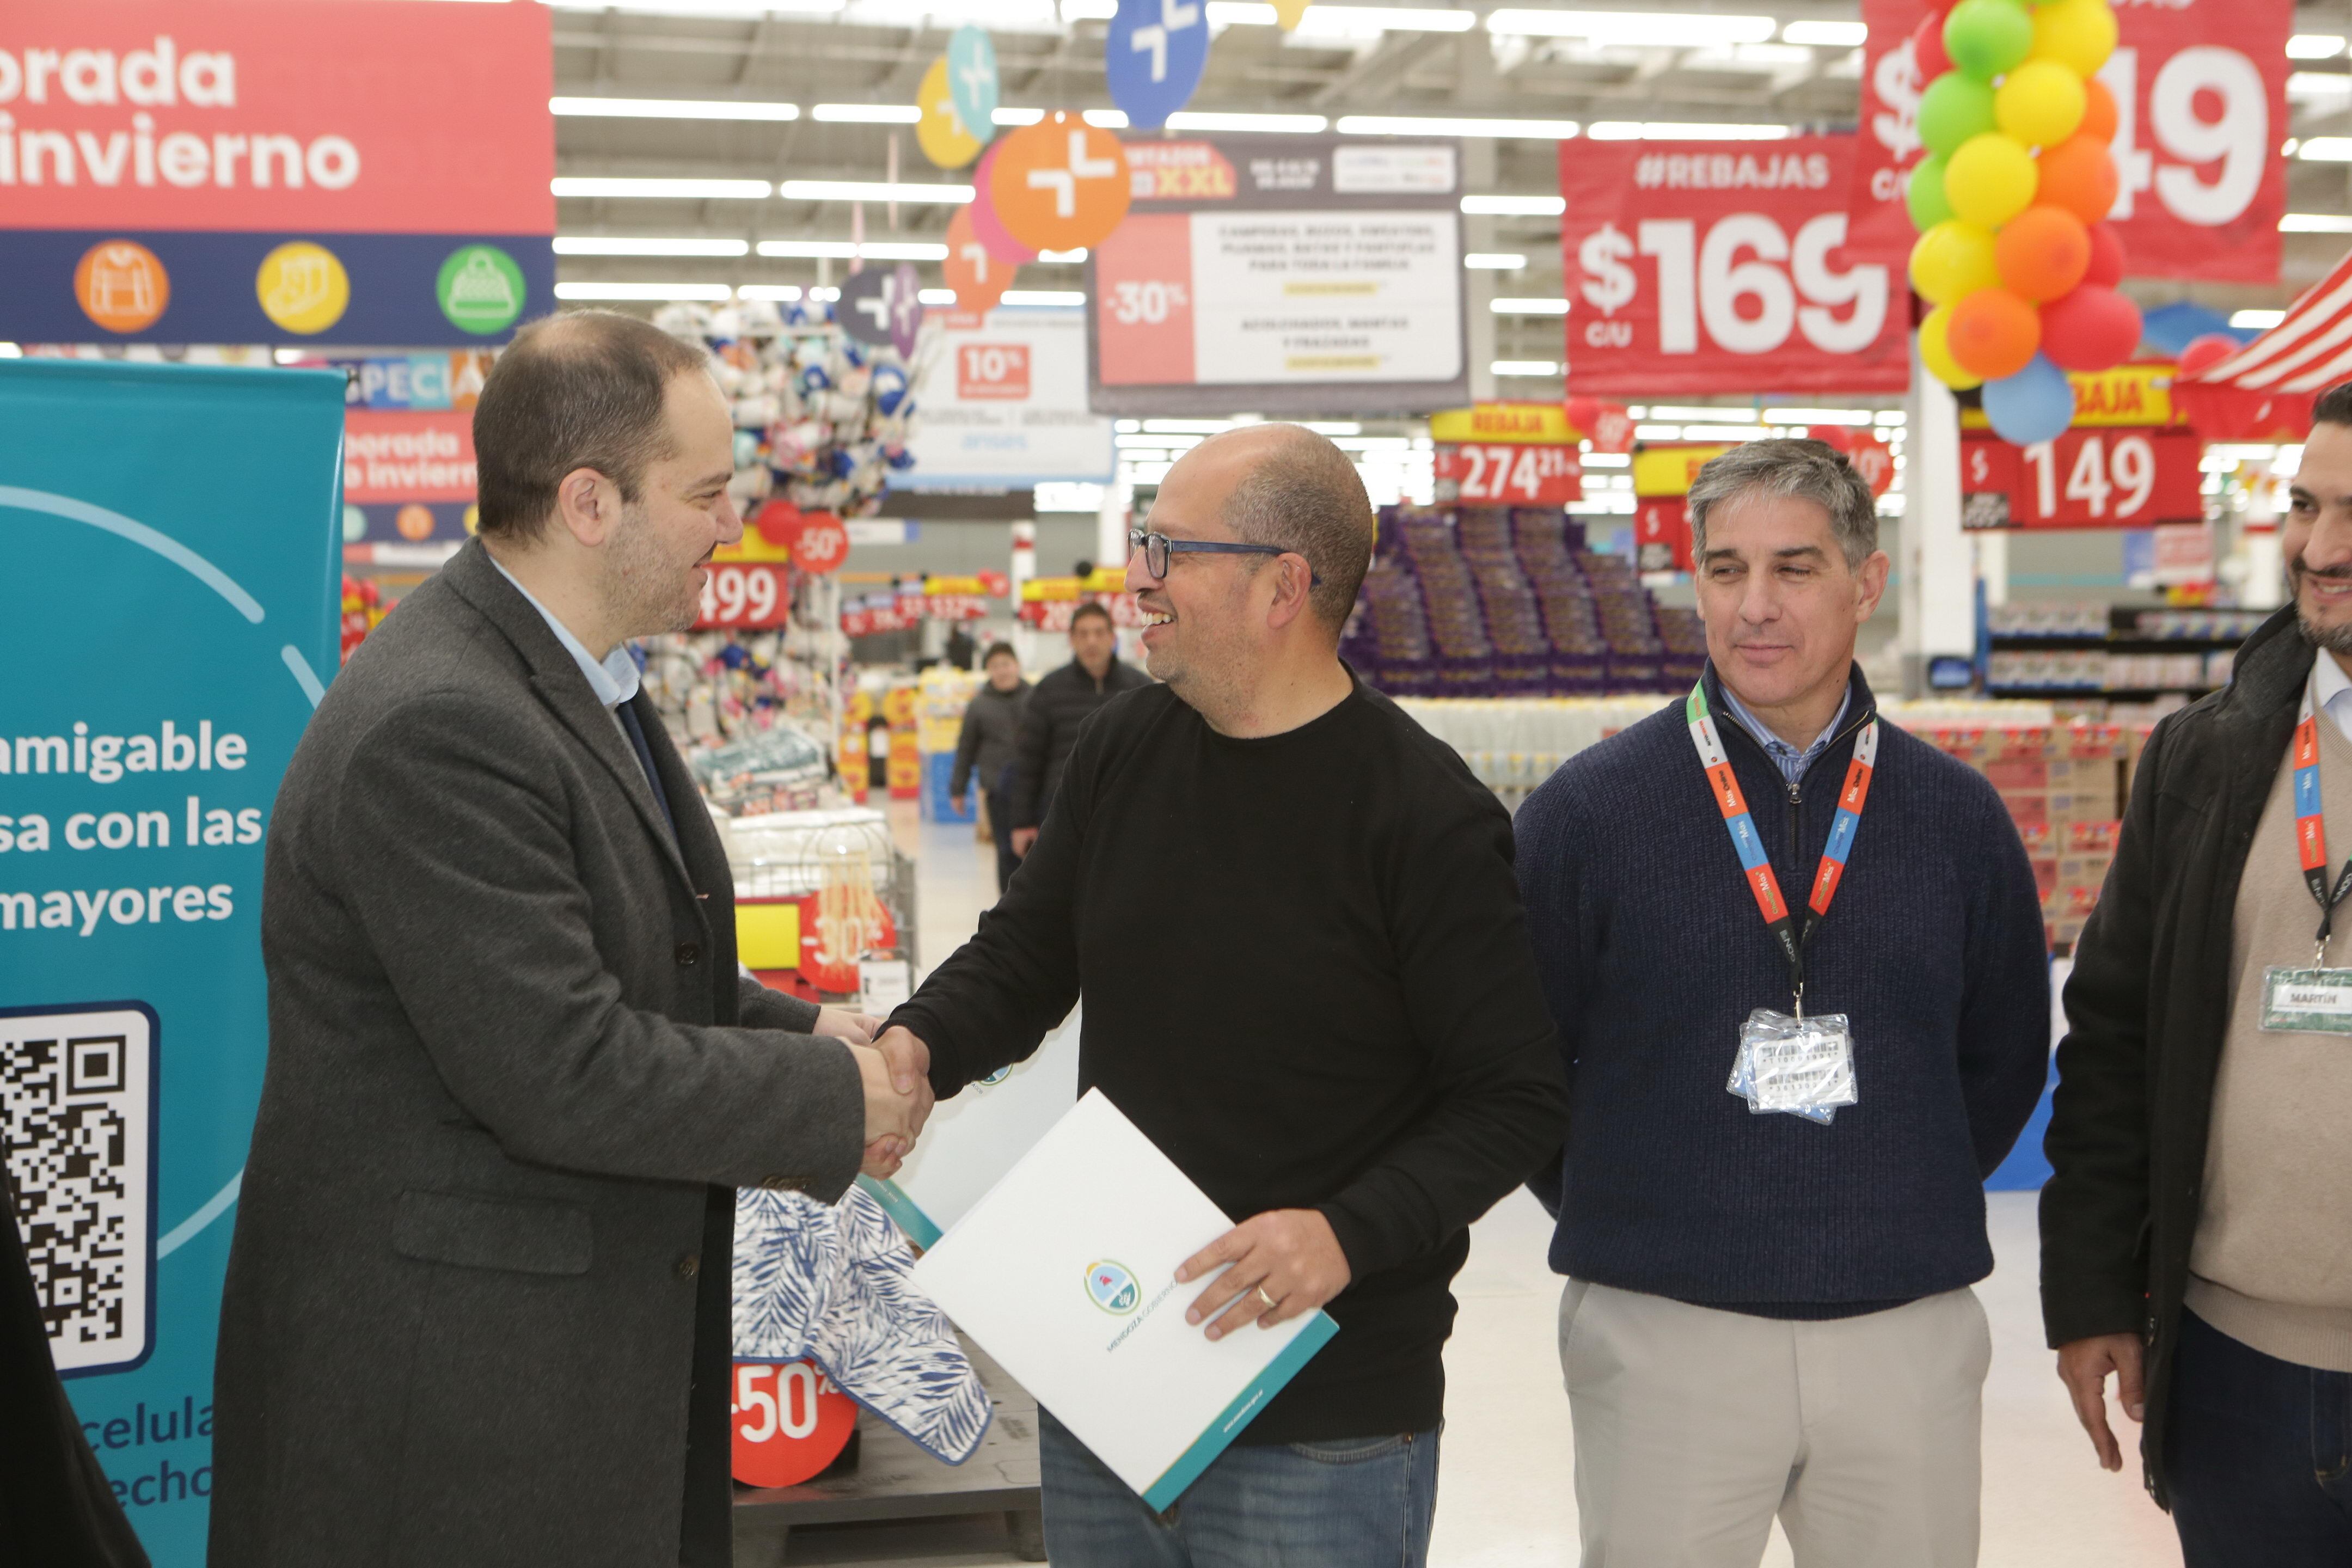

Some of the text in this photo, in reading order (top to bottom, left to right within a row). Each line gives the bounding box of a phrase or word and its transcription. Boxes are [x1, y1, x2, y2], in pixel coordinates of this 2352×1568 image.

[1634, 152, 1830, 189] #REBAJAS
[1459, 444, 1541, 499] 274
[2022, 434, 2156, 519] 149
[65, 809, 170, 850] con
[187, 795, 262, 846] las
[1106, 1316, 1144, 1354] MENDOZA
